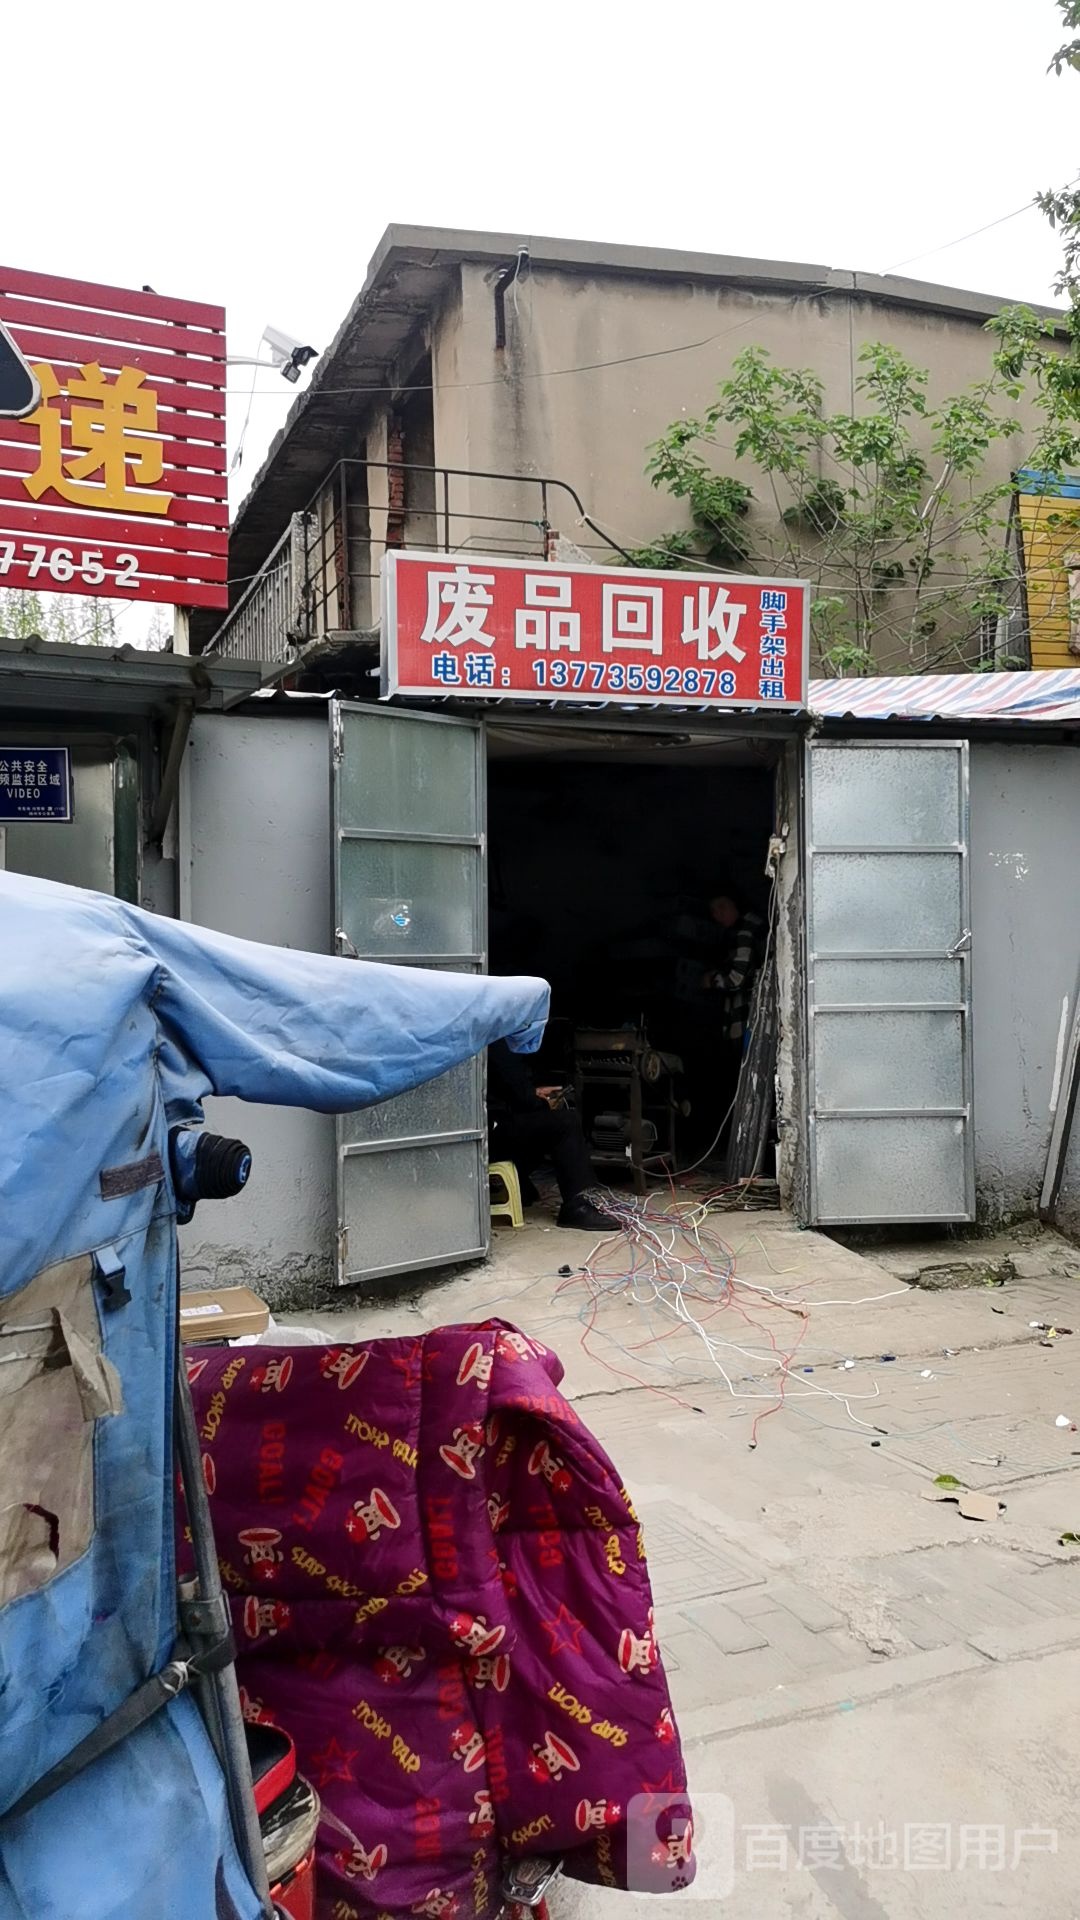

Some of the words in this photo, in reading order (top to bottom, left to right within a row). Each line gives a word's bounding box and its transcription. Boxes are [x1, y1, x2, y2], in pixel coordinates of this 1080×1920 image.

[19, 361, 173, 514] 递
[420, 566, 747, 664] 废品回收
[760, 591, 787, 700] 脚手架出租
[0, 760, 48, 772] 公共安全
[0, 774, 61, 786] 频监控区域
[7, 788, 40, 798] VIDEO
